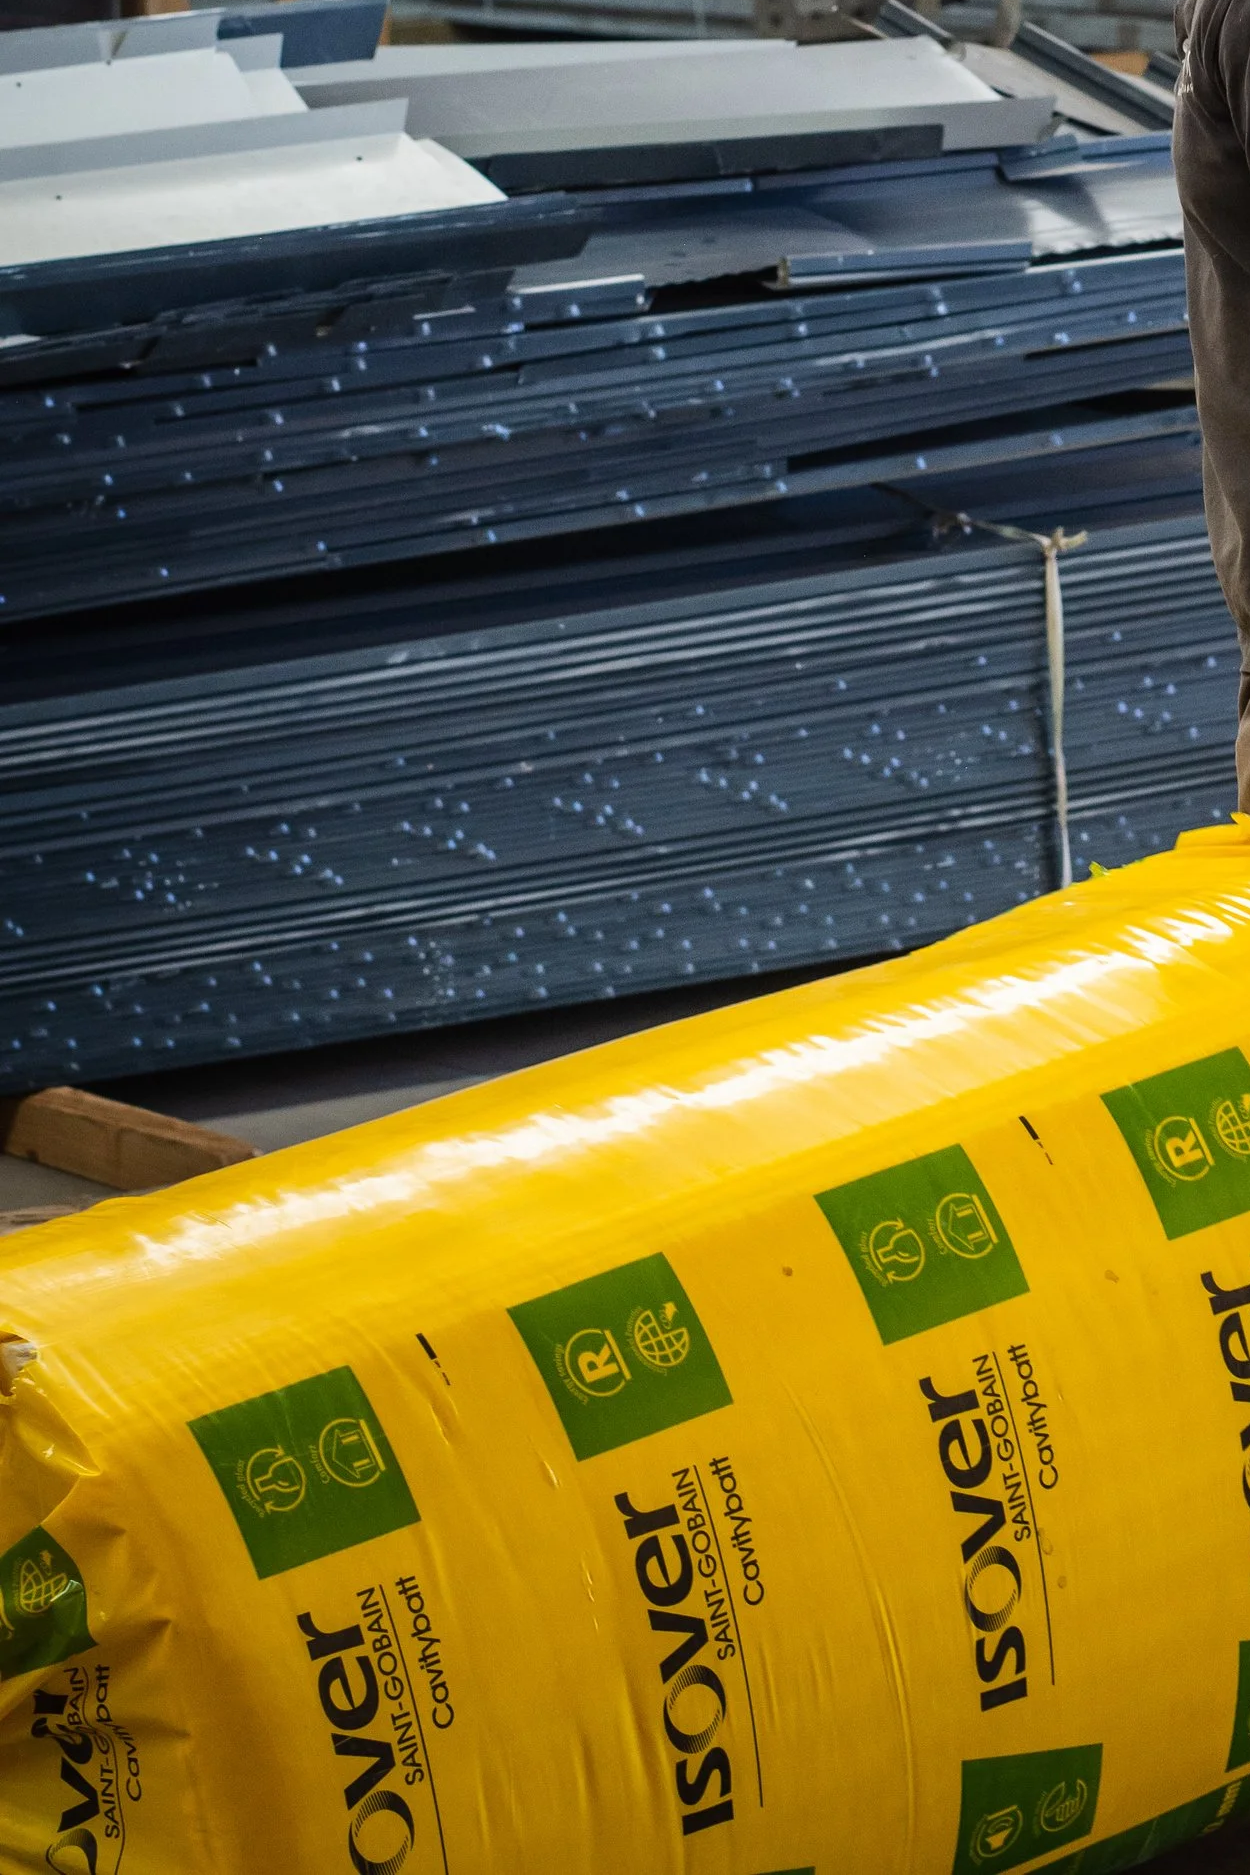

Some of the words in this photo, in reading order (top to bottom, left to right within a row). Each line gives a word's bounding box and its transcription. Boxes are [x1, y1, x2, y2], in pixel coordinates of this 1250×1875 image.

[308, 1444, 331, 1485] Comfort
[972, 1354, 1032, 1542] SAINT-GOBAIN
[1007, 1343, 1059, 1490] Cavitybatt
[672, 1467, 737, 1662] SAINT-GOBAIN
[709, 1456, 765, 1606] Cavitybatt
[356, 1586, 426, 1786] SAINT-GOBAIN
[395, 1575, 456, 1730] Cavitybatt
[64, 1667, 120, 1839] SAINT-GBAIN
